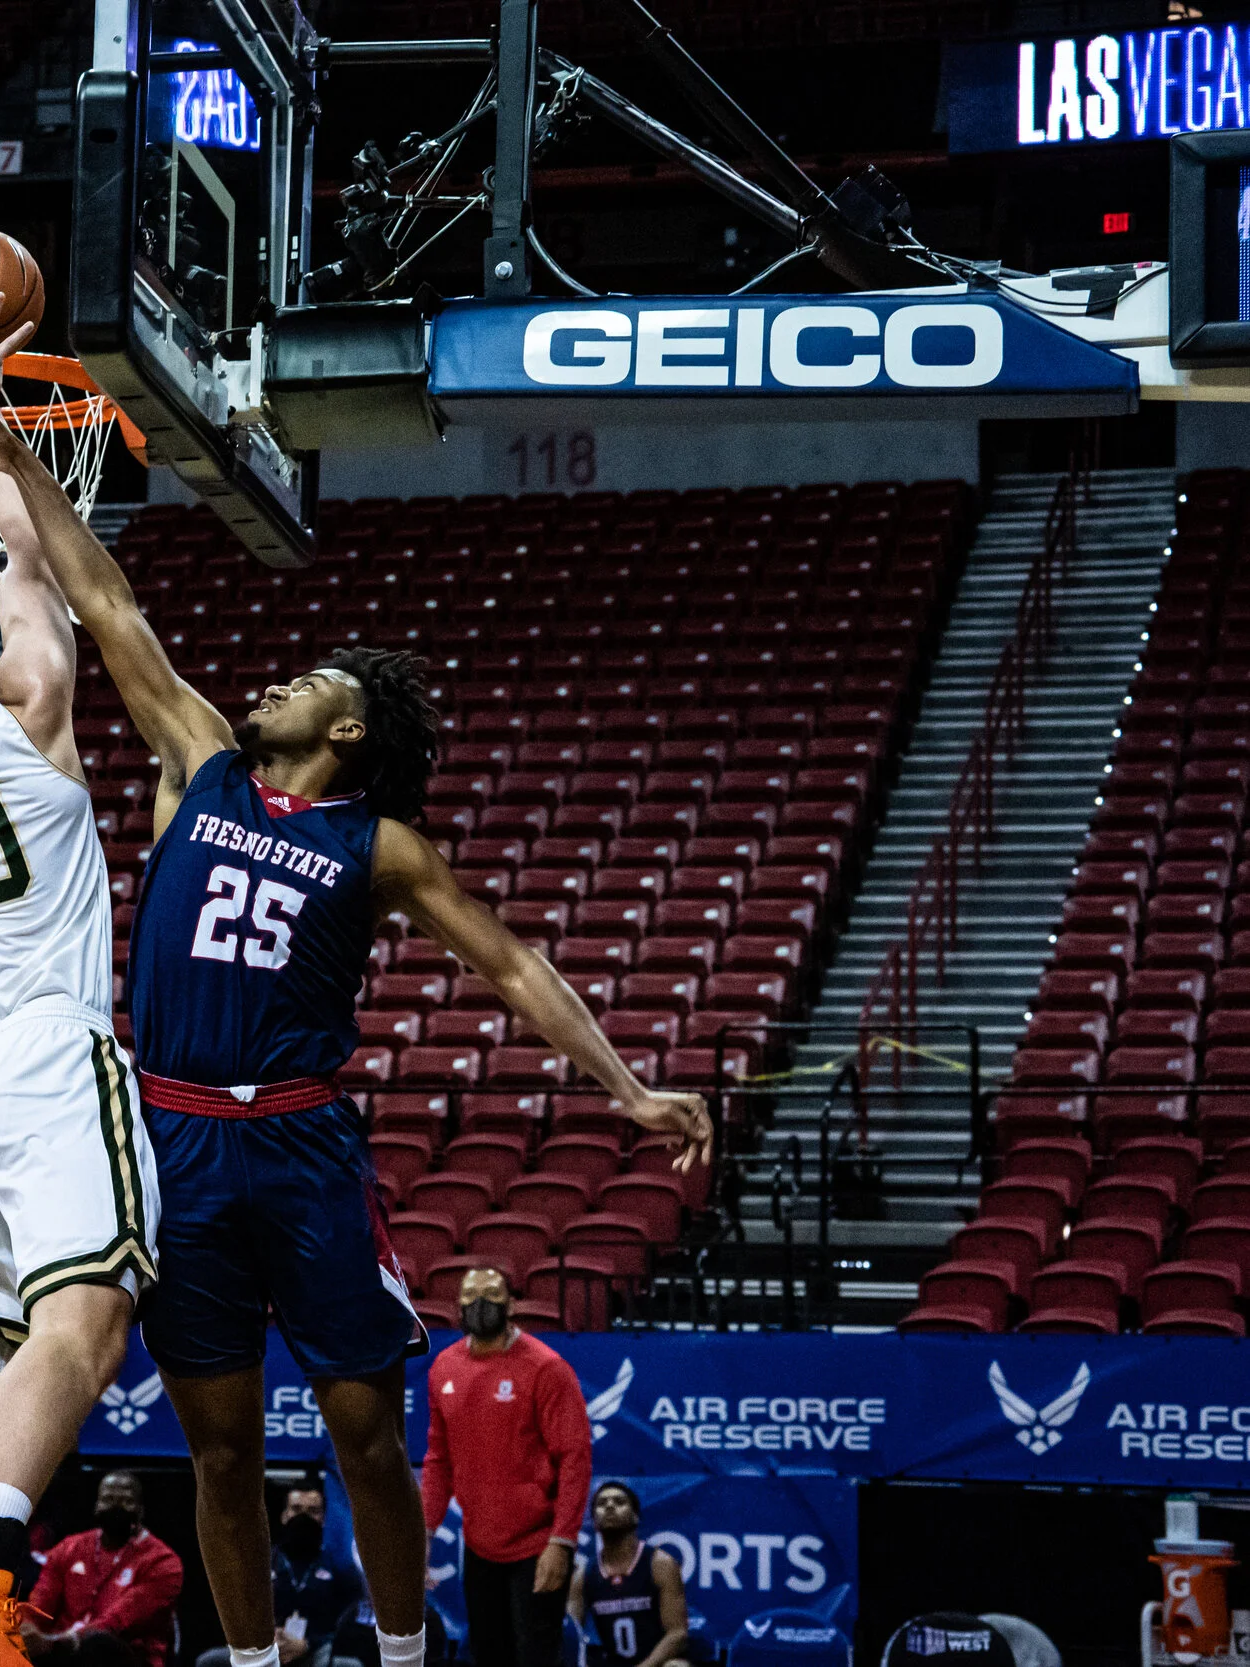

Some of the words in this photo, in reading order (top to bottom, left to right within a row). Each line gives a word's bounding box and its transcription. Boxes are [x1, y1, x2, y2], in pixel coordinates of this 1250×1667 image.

[1018, 34, 1120, 145] LAS
[1125, 25, 1250, 136] VEGA
[0, 145, 17, 171] 7
[523, 303, 1004, 388] GEICO
[507, 429, 597, 486] 118
[189, 813, 274, 862] FRESNO
[270, 839, 344, 889] STATE
[190, 864, 310, 971] 25
[649, 1396, 728, 1422] AIR
[738, 1397, 886, 1424] FORCE
[1106, 1402, 1188, 1431] AIR
[663, 1423, 871, 1451] RESERVE
[1121, 1431, 1250, 1461] RESE
[1167, 1568, 1192, 1599] G
[612, 1616, 638, 1660] 0
